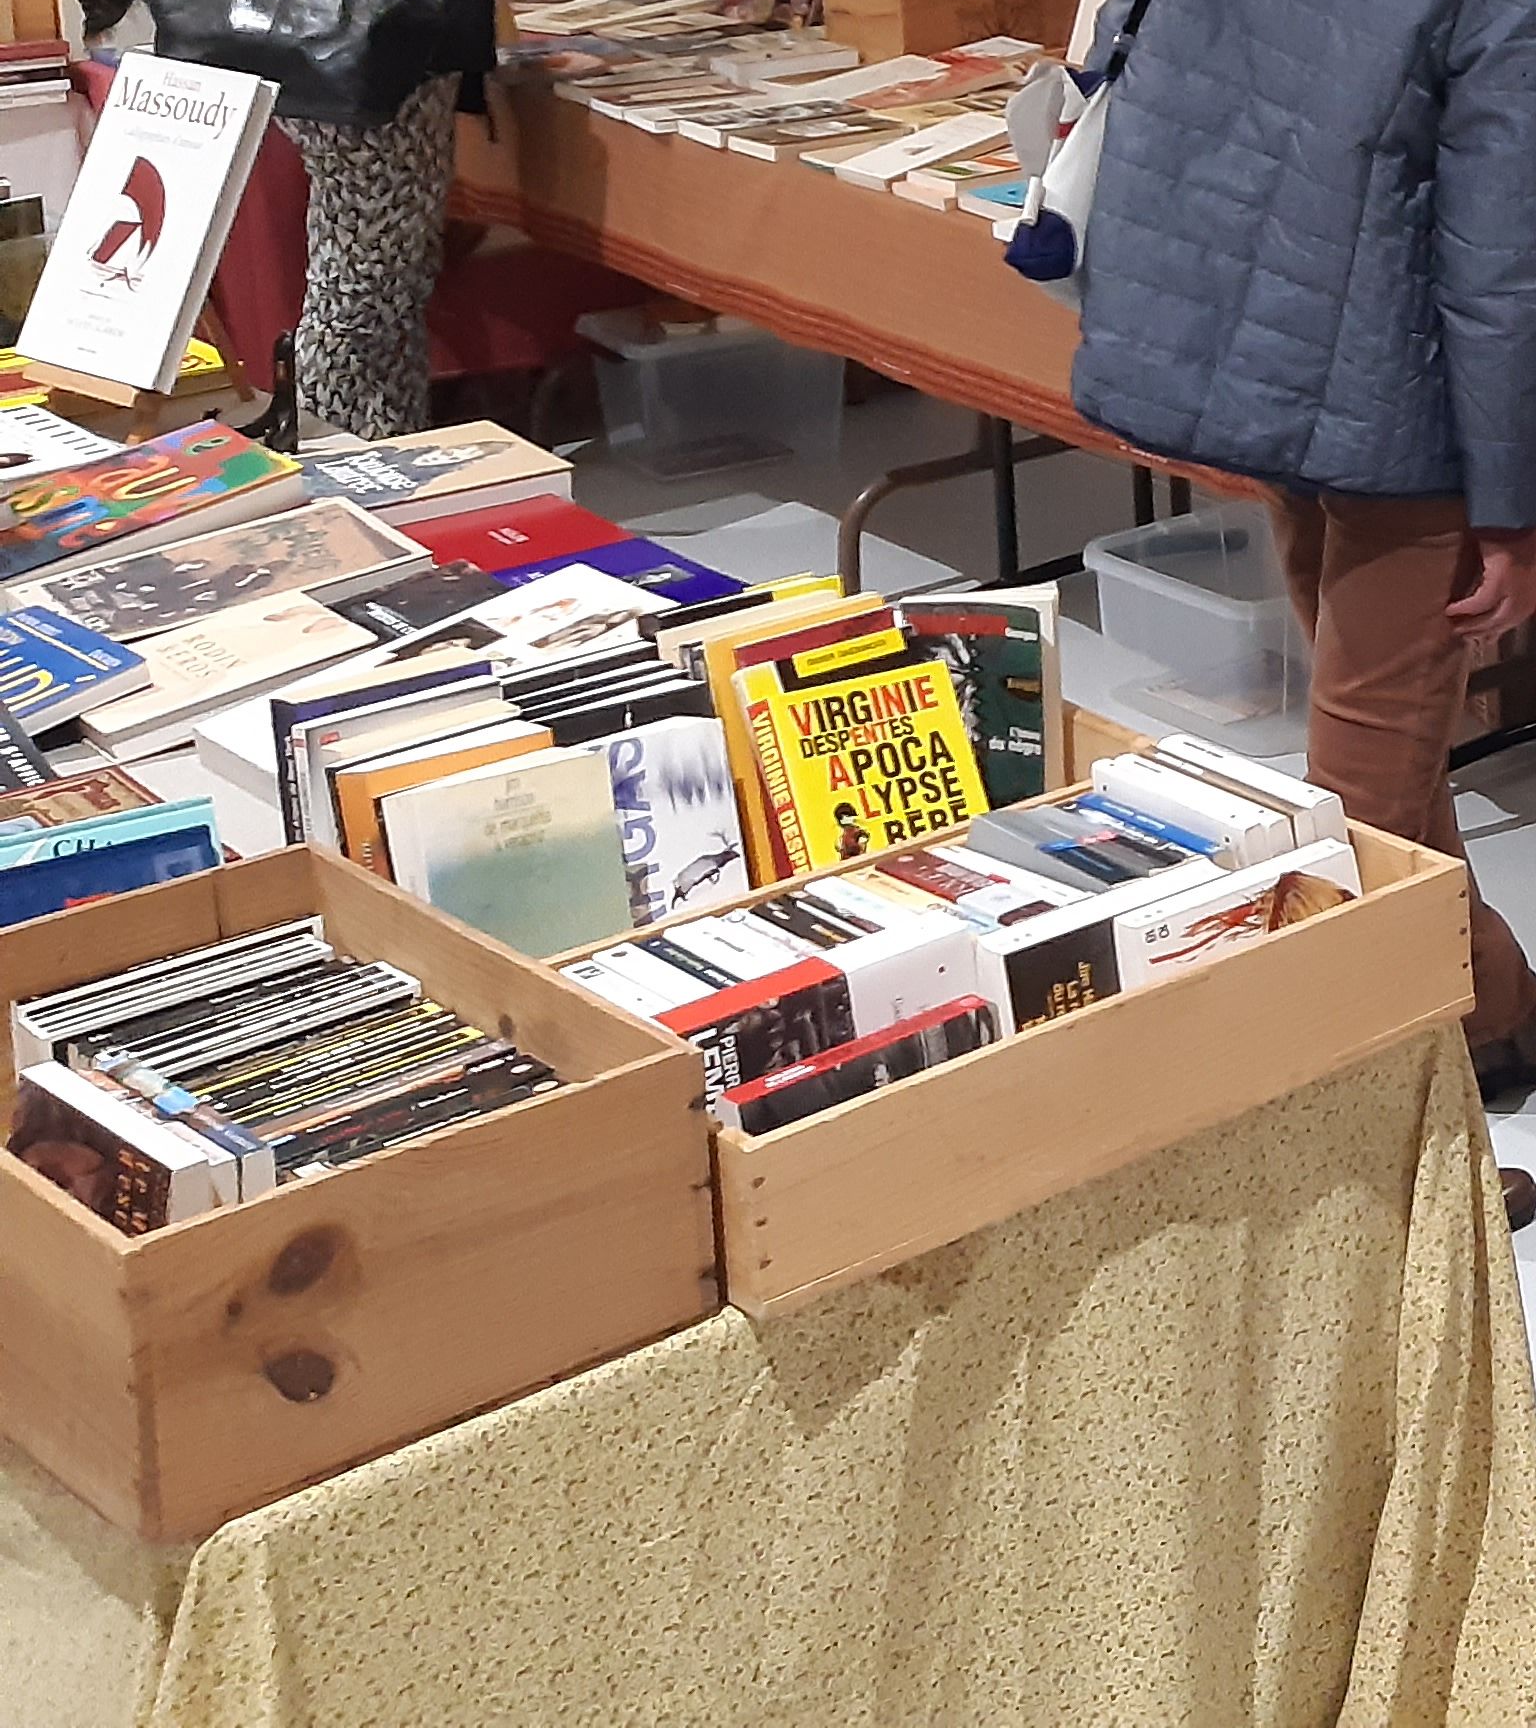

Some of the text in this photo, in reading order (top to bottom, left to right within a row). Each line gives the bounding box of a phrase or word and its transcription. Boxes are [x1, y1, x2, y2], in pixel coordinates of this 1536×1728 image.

[114, 75, 238, 140] Massoudy
[787, 675, 939, 737] VIRGINIE
[800, 715, 915, 760] DESPENTES
[829, 730, 956, 792] APOCA
[858, 765, 964, 819] LYPSE
